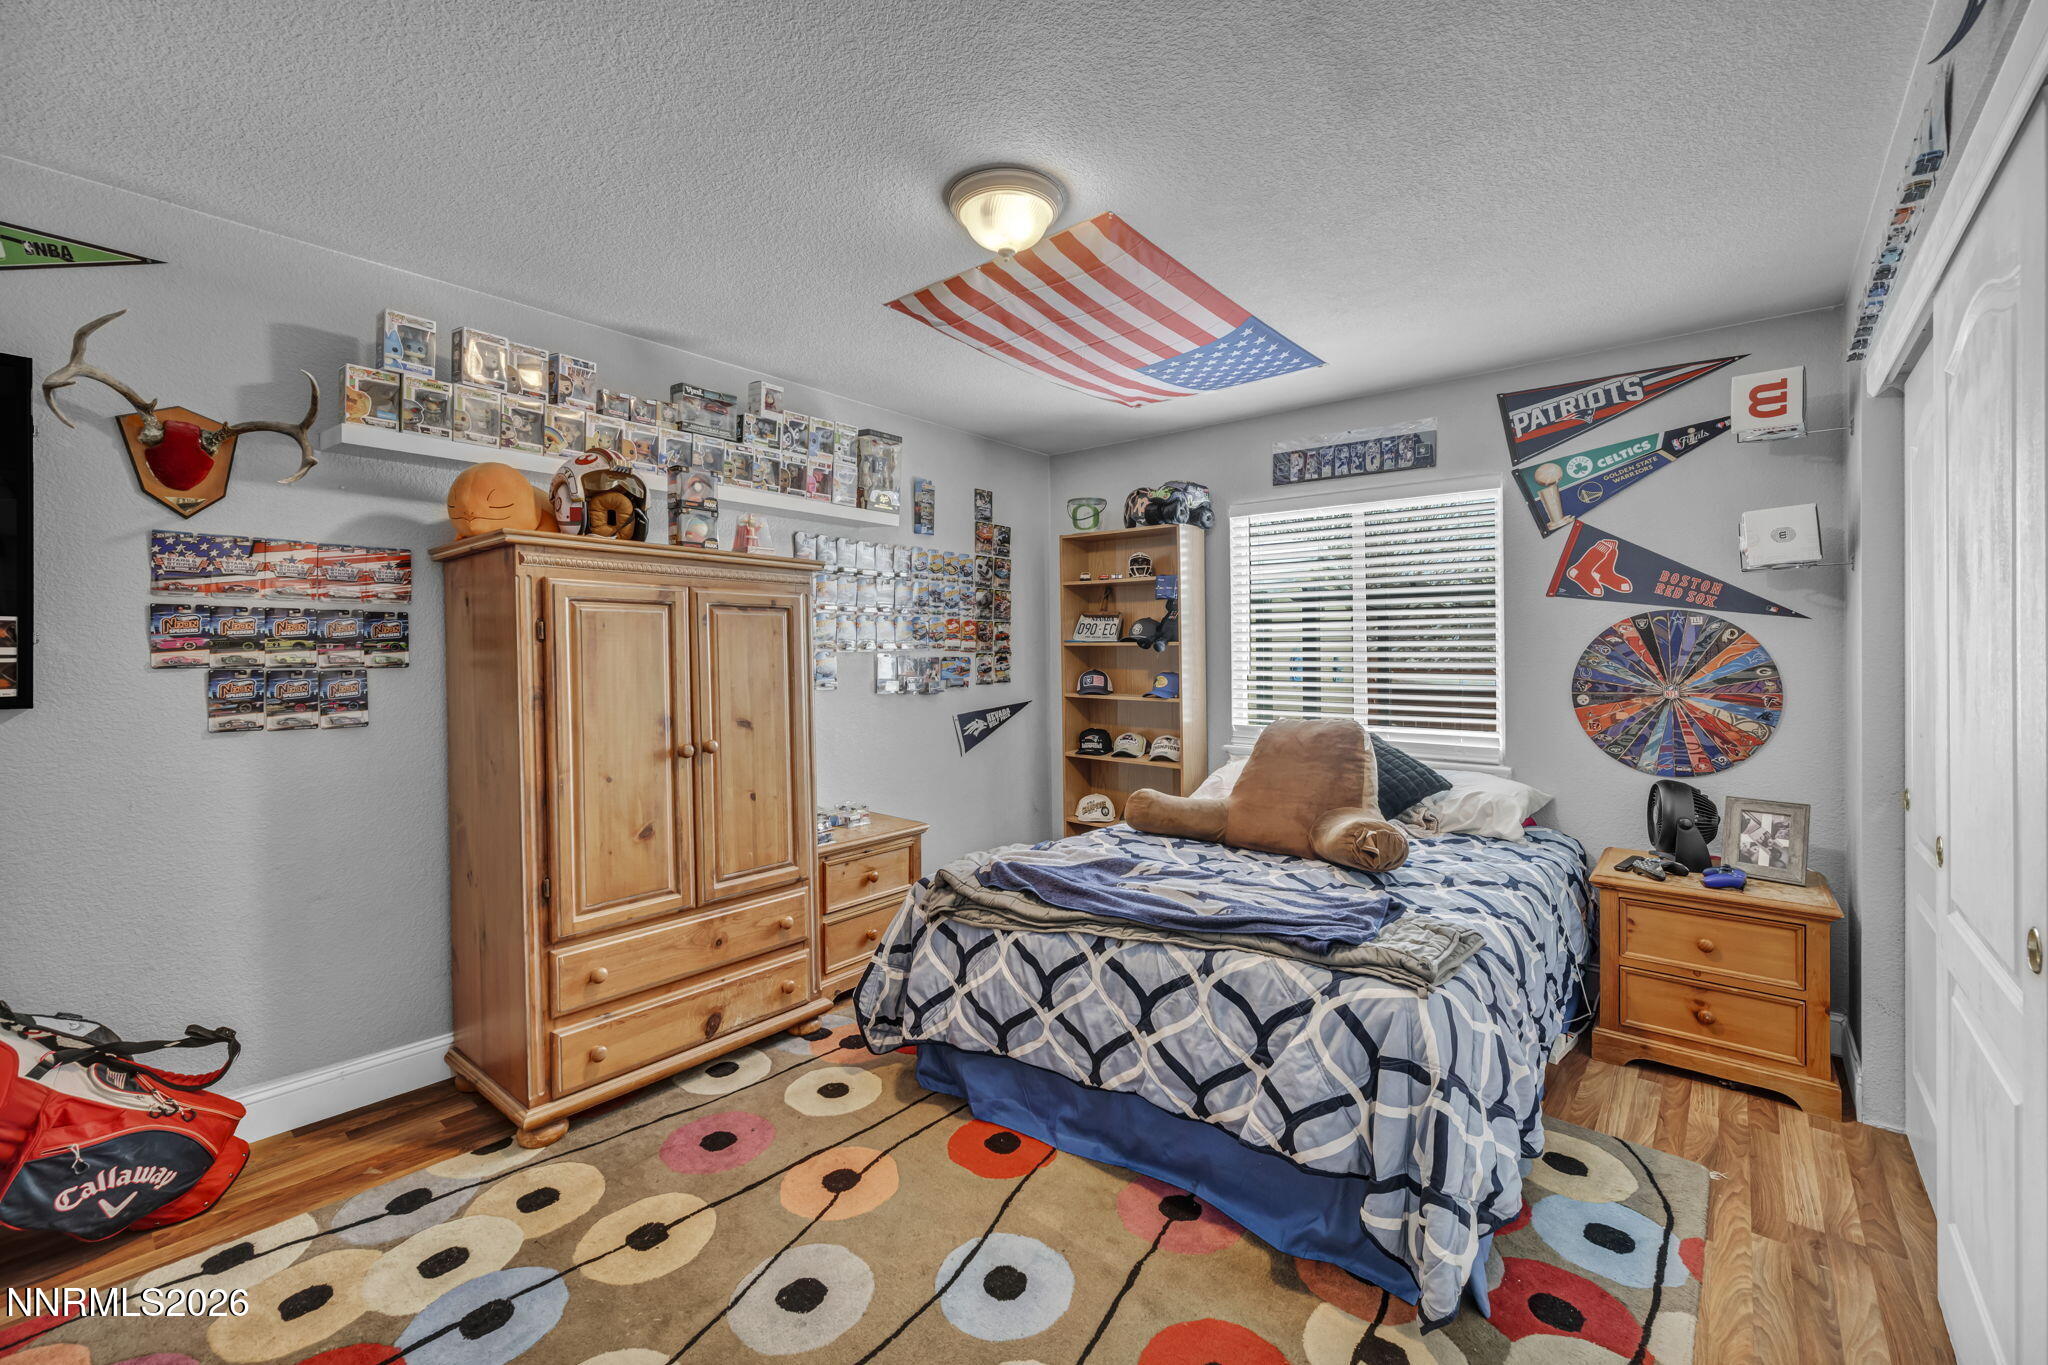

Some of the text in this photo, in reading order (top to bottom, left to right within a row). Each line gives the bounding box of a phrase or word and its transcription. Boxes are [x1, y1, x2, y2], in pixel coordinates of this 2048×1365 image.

[33, 242, 74, 260] NBA
[1512, 376, 1644, 438] PATRIOTS
[1290, 434, 1415, 482] PATRIOTS
[1597, 440, 1651, 468] CELTICS
[1603, 455, 1658, 481] GOLDEN STATE
[1612, 465, 1654, 484] WARRIORS
[1654, 582, 1718, 608] RED SOX
[1659, 570, 1723, 595] BOSTON
[54, 1165, 178, 1212] Callaway
